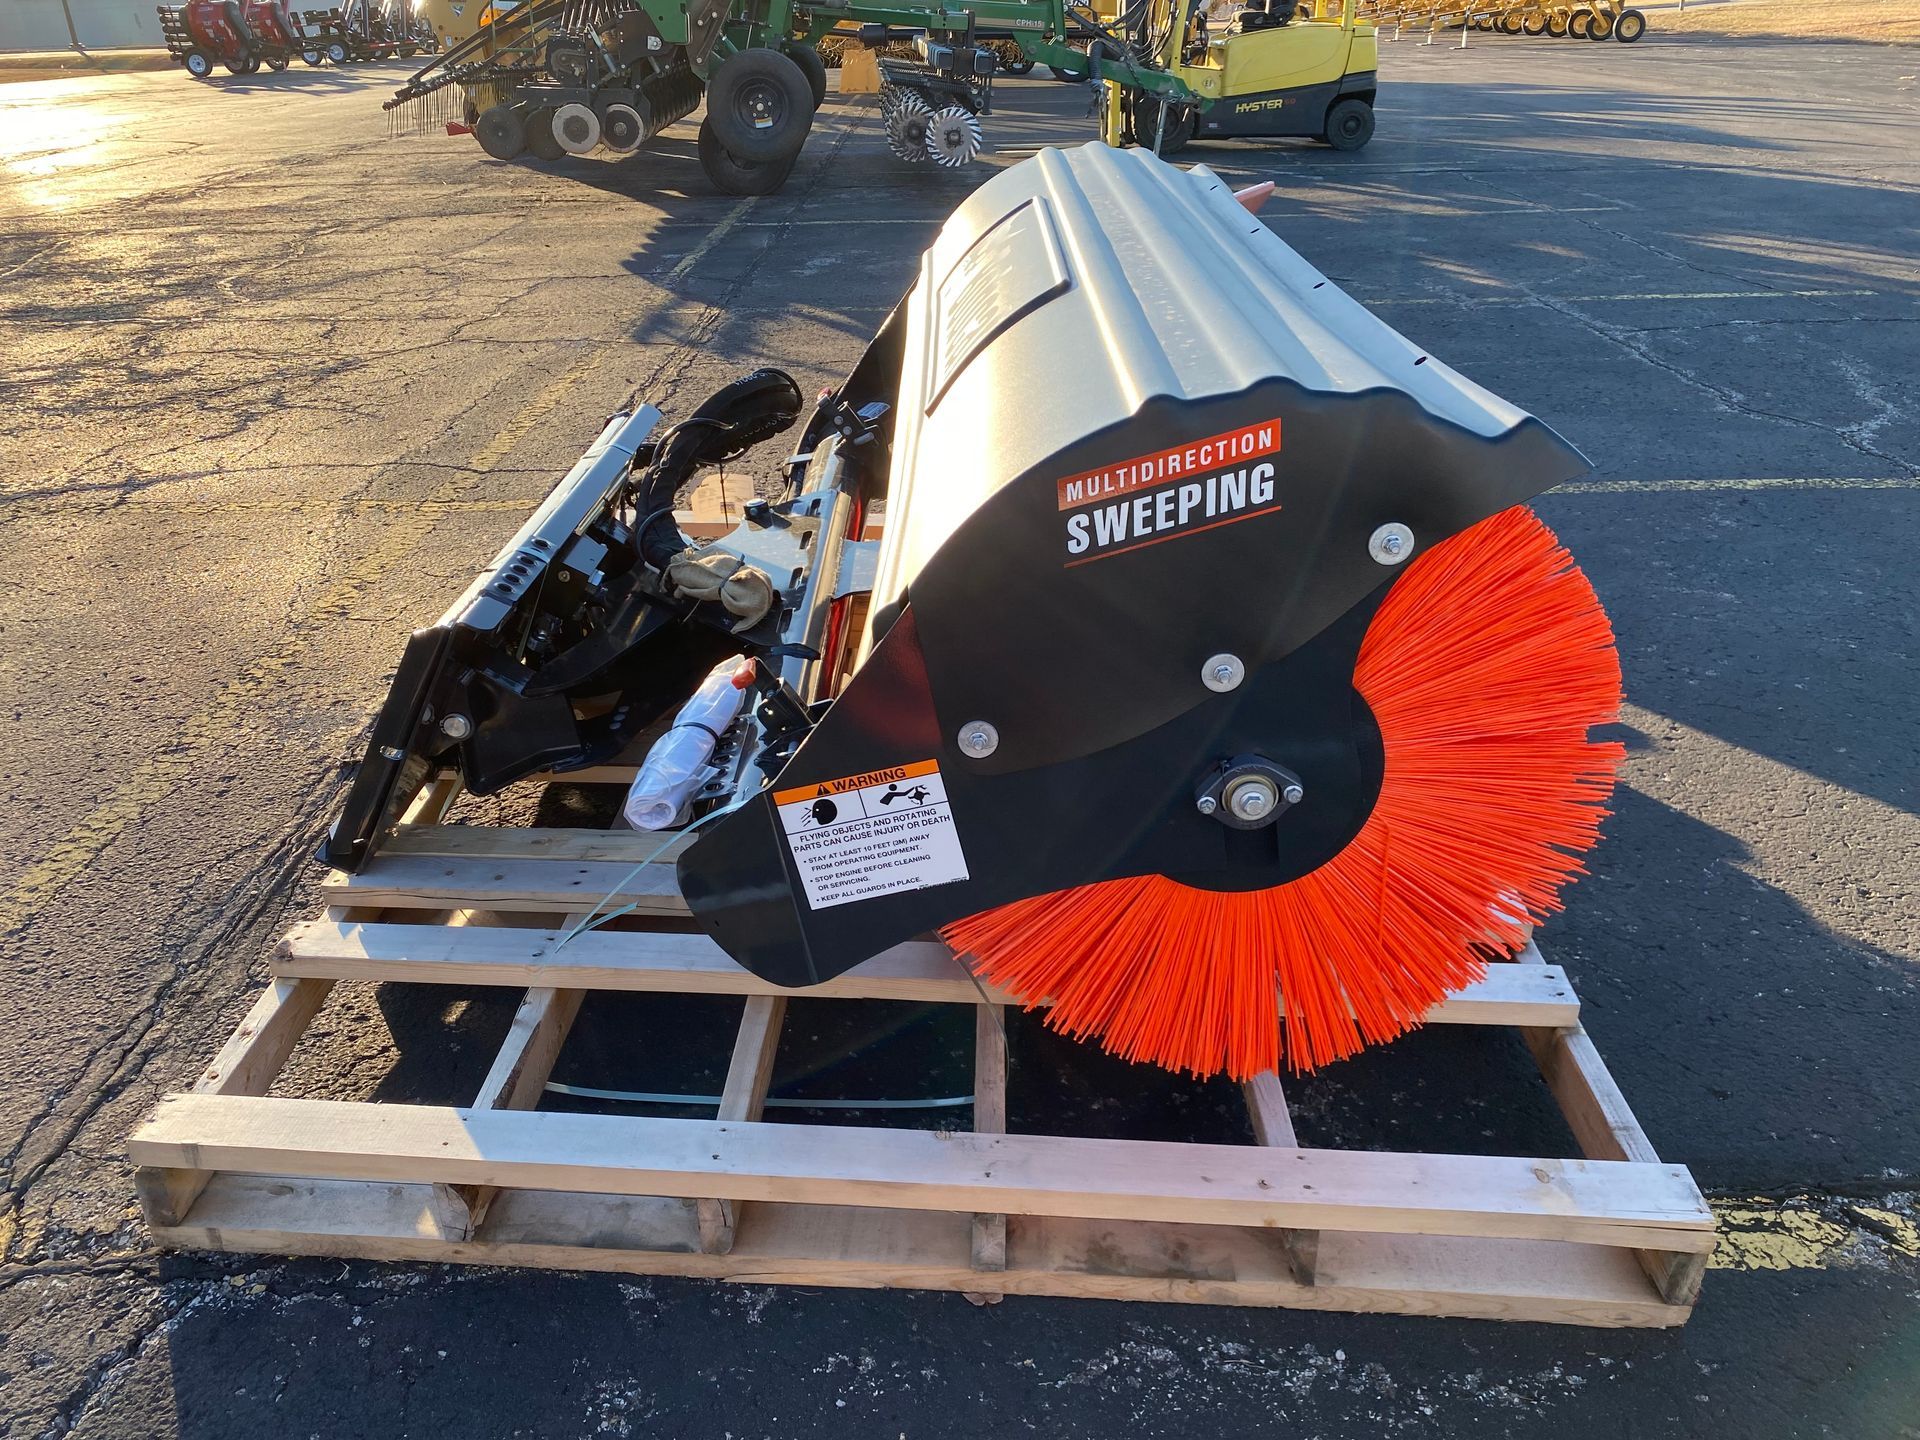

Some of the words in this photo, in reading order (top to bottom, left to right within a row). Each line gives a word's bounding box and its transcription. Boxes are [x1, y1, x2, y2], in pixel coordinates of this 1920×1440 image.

[1235, 98, 1283, 113] HYSTER
[1066, 428, 1272, 502] MULTIDIRECTION
[1066, 462, 1275, 554] SWEEPING
[832, 768, 906, 792] WARNING
[794, 842, 822, 853] PARTS
[824, 838, 842, 846] CAN
[843, 831, 872, 842] CAUSE
[874, 824, 905, 836] INJURY
[907, 821, 920, 830] OR
[922, 814, 951, 826] DEATH
[800, 830, 830, 842] FLYING
[832, 822, 871, 835] OBJECTS
[873, 818, 891, 828] AND
[892, 808, 936, 823] ROTATING
[808, 855, 826, 864] STAY
[840, 848, 862, 856] LEAST
[873, 842, 891, 850] FEET
[893, 838, 908, 846] (3M)
[909, 833, 930, 843] AWAY
[811, 863, 832, 872] FROM
[834, 854, 876, 867] OPERATING
[877, 845, 922, 858] EQUIPMENT.
[815, 874, 834, 882] STOP
[835, 868, 862, 878] ENGINE
[864, 862, 893, 873] BEFORE
[894, 854, 931, 866] CLEANING
[830, 876, 870, 888] SERVICING.
[821, 893, 840, 902] KEEP
[856, 884, 886, 894] GUARDS
[896, 877, 922, 886] PLACE.
